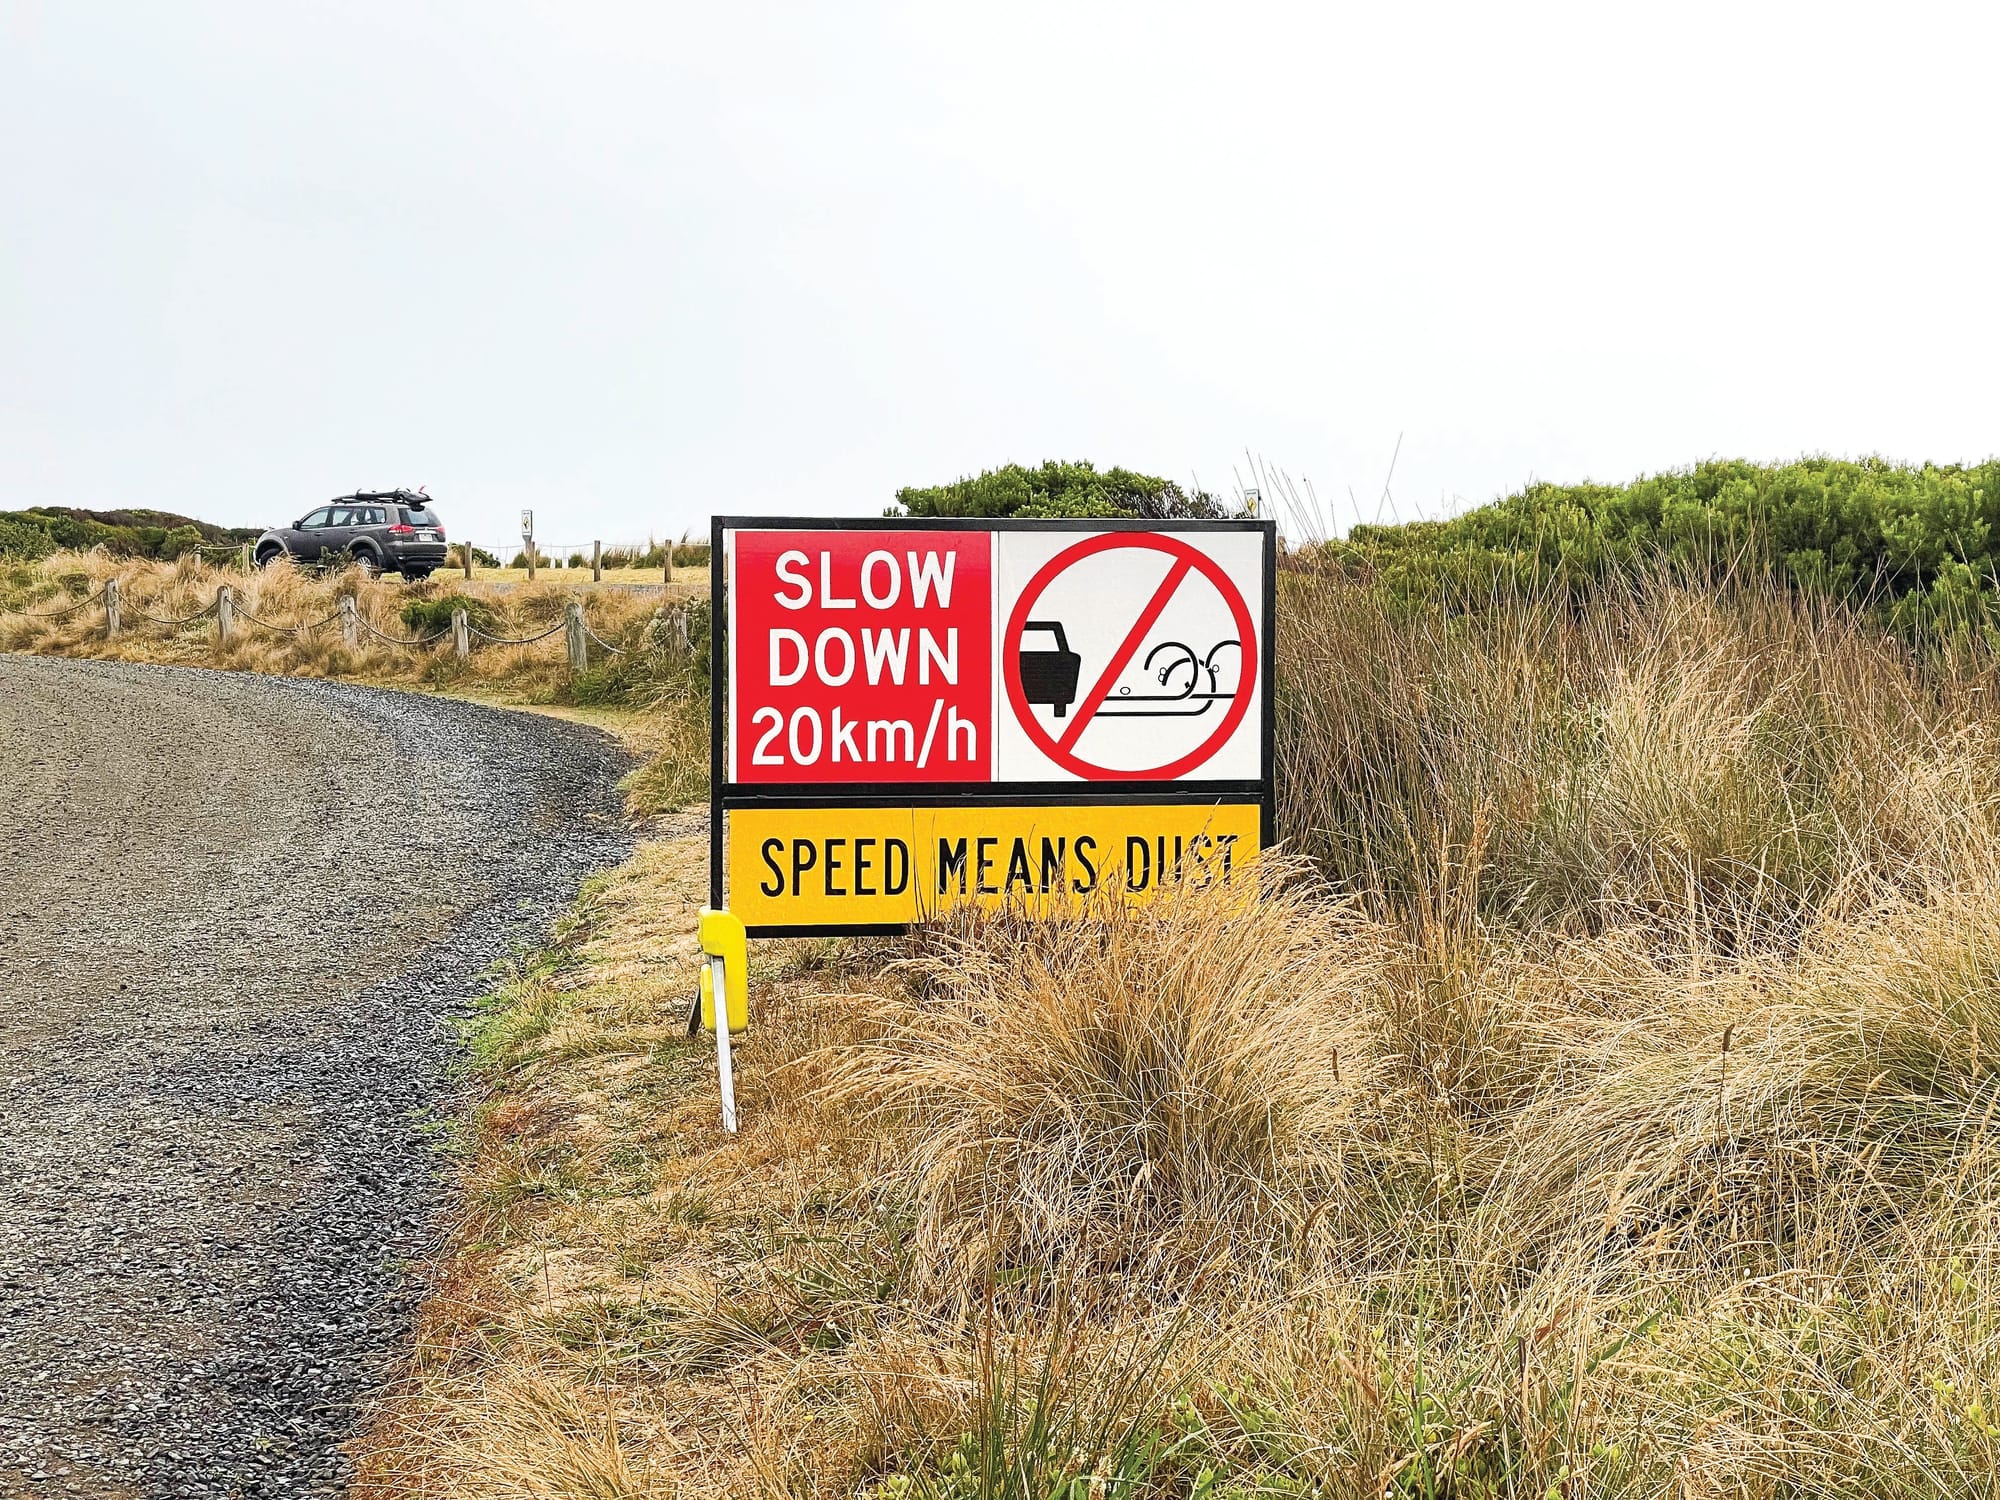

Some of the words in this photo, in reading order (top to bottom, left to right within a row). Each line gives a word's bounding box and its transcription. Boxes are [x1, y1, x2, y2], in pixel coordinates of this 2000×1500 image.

[773, 549, 957, 610] SLOW
[769, 627, 958, 687] DOWN
[751, 698, 977, 768] 20km/h
[760, 837, 909, 898] SPEED
[938, 835, 1098, 895] MEANS
